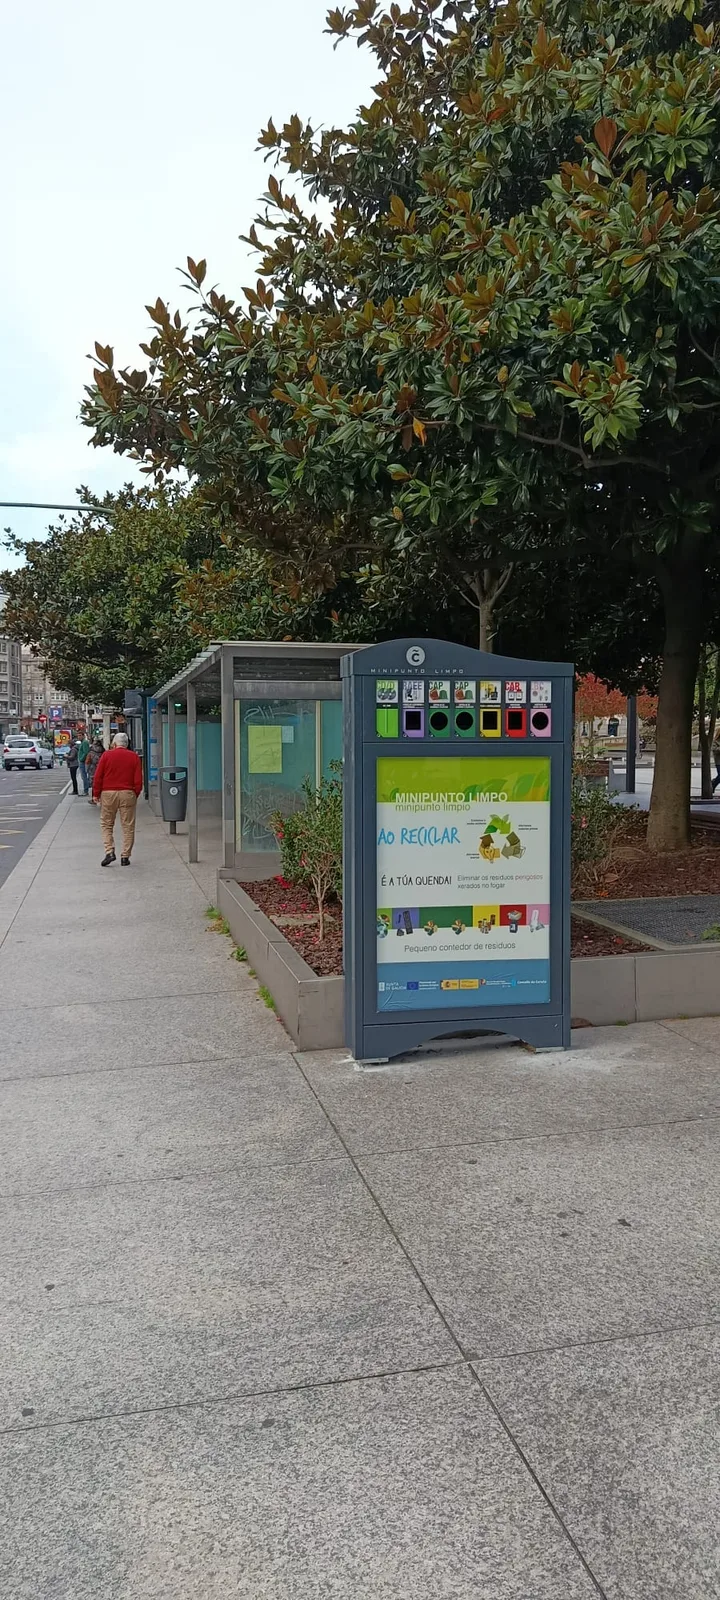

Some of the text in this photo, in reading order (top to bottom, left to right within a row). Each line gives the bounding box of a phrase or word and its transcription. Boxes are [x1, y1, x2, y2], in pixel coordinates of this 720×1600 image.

[395, 791, 508, 803] MINIPUNTO LIMPO
[395, 802, 471, 813] minipunto limpio
[377, 826, 461, 847] AO RECICLAR
[381, 874, 387, 887] É
[389, 877, 395, 886] A
[396, 874, 415, 886] TÚA
[457, 874, 480, 882] Eliminar
[489, 873, 514, 881] residuos
[514, 873, 543, 882] perigosos
[457, 882, 481, 890] xerados
[490, 881, 505, 890] fogar
[404, 941, 516, 953] Pequeno contedor de residuos
